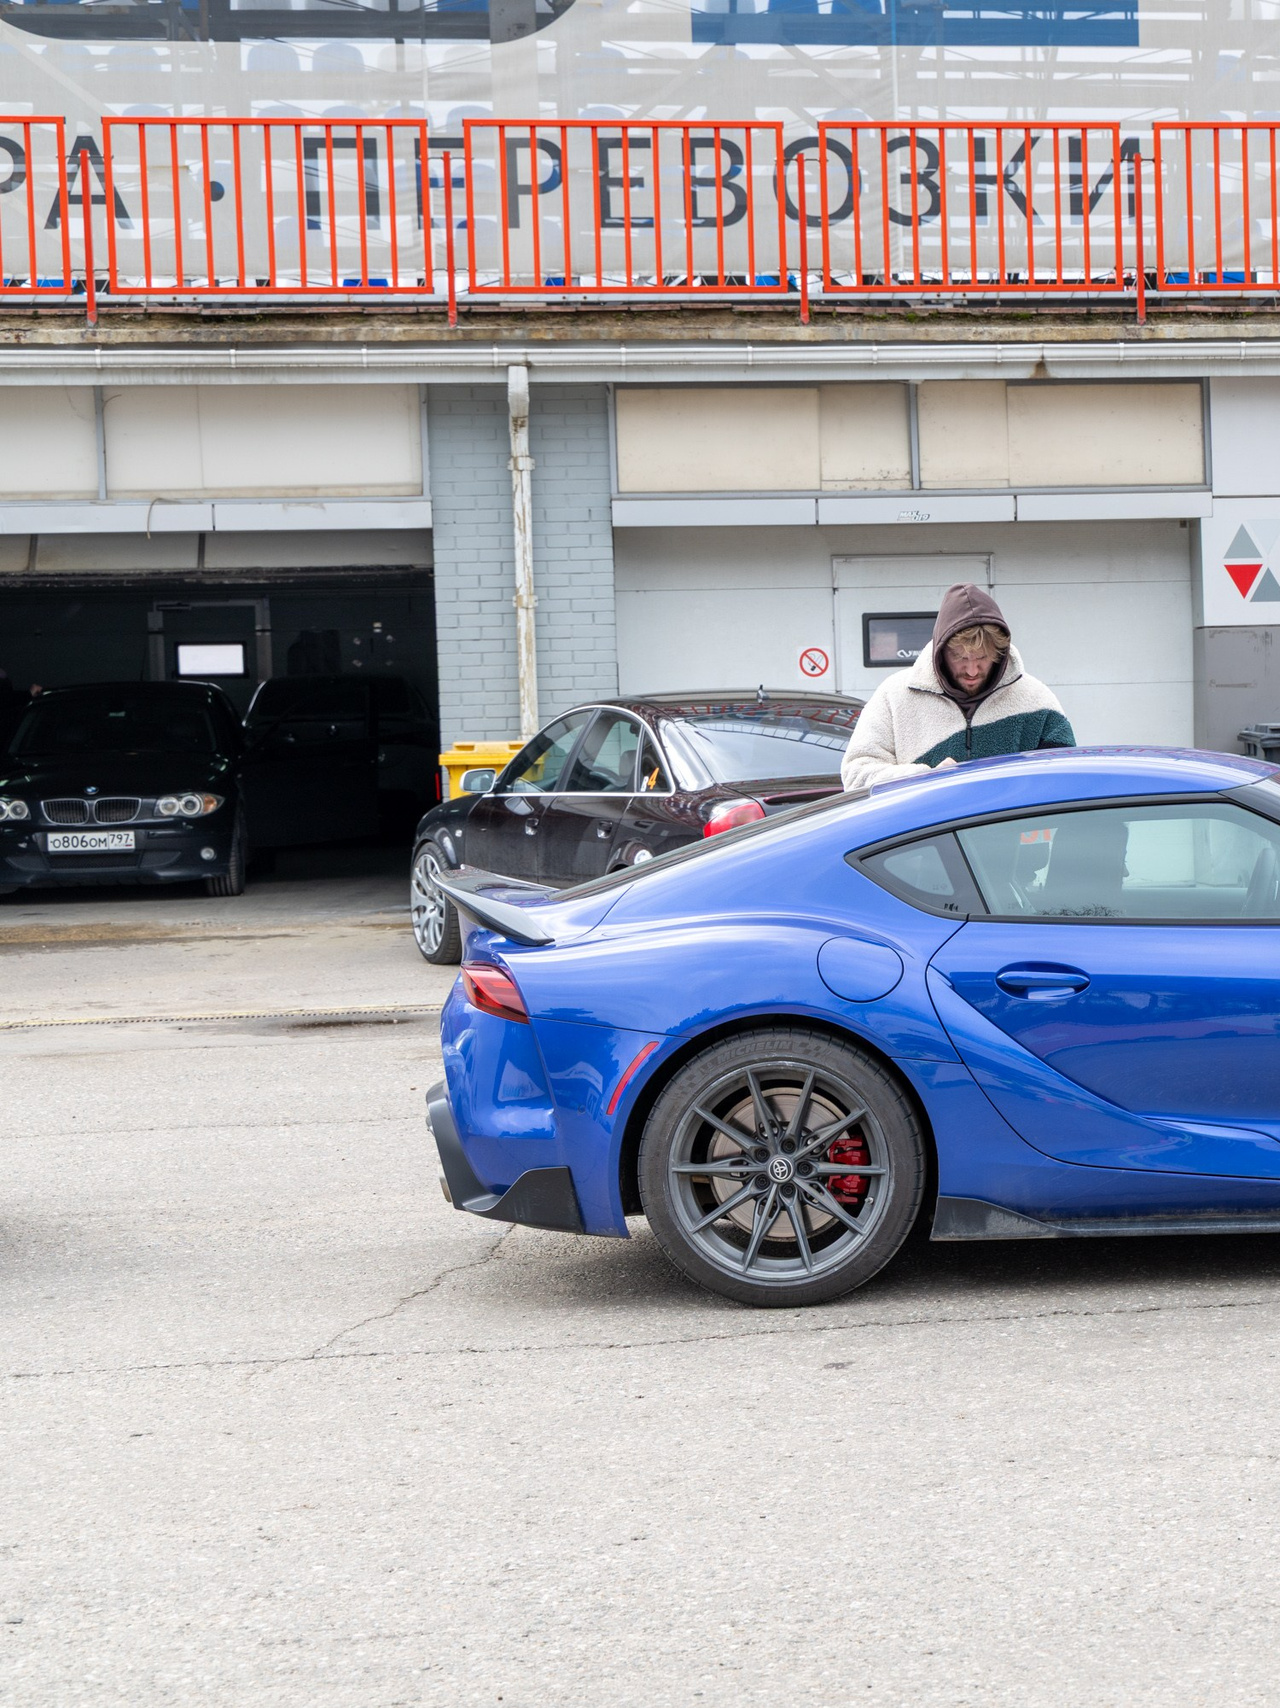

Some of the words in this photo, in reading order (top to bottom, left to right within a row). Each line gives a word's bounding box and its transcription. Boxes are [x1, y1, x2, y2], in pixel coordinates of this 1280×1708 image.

[305, 135, 1142, 231] ПЕРЕВОЗКИ
[109, 833, 130, 845] 797
[716, 1040, 793, 1065] MICHELIN
